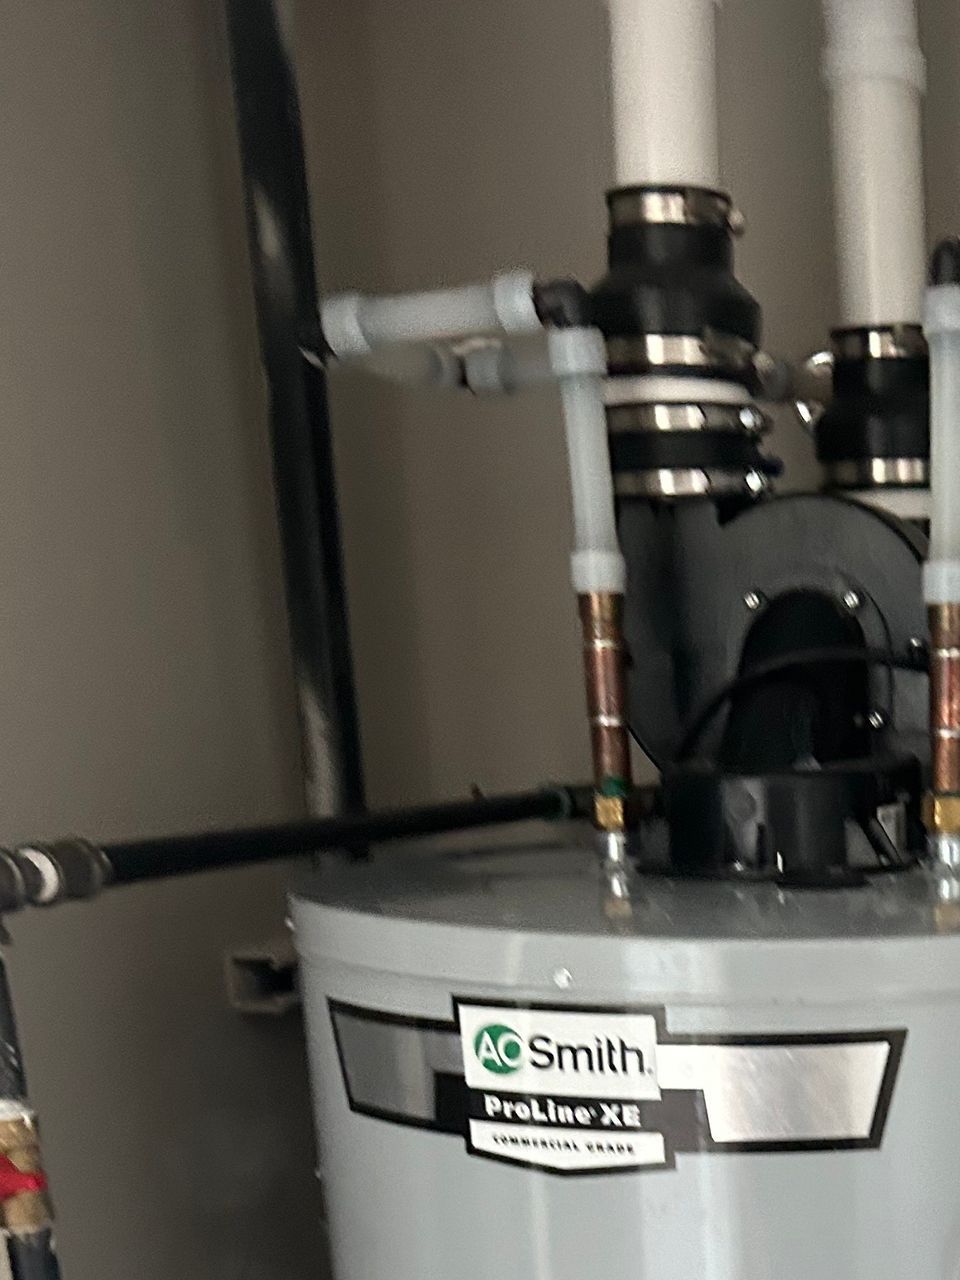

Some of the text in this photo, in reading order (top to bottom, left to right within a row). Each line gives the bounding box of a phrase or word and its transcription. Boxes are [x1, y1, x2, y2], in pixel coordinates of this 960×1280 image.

[528, 1034, 646, 1074] Smith
[484, 1093, 642, 1128] ProLine XE
